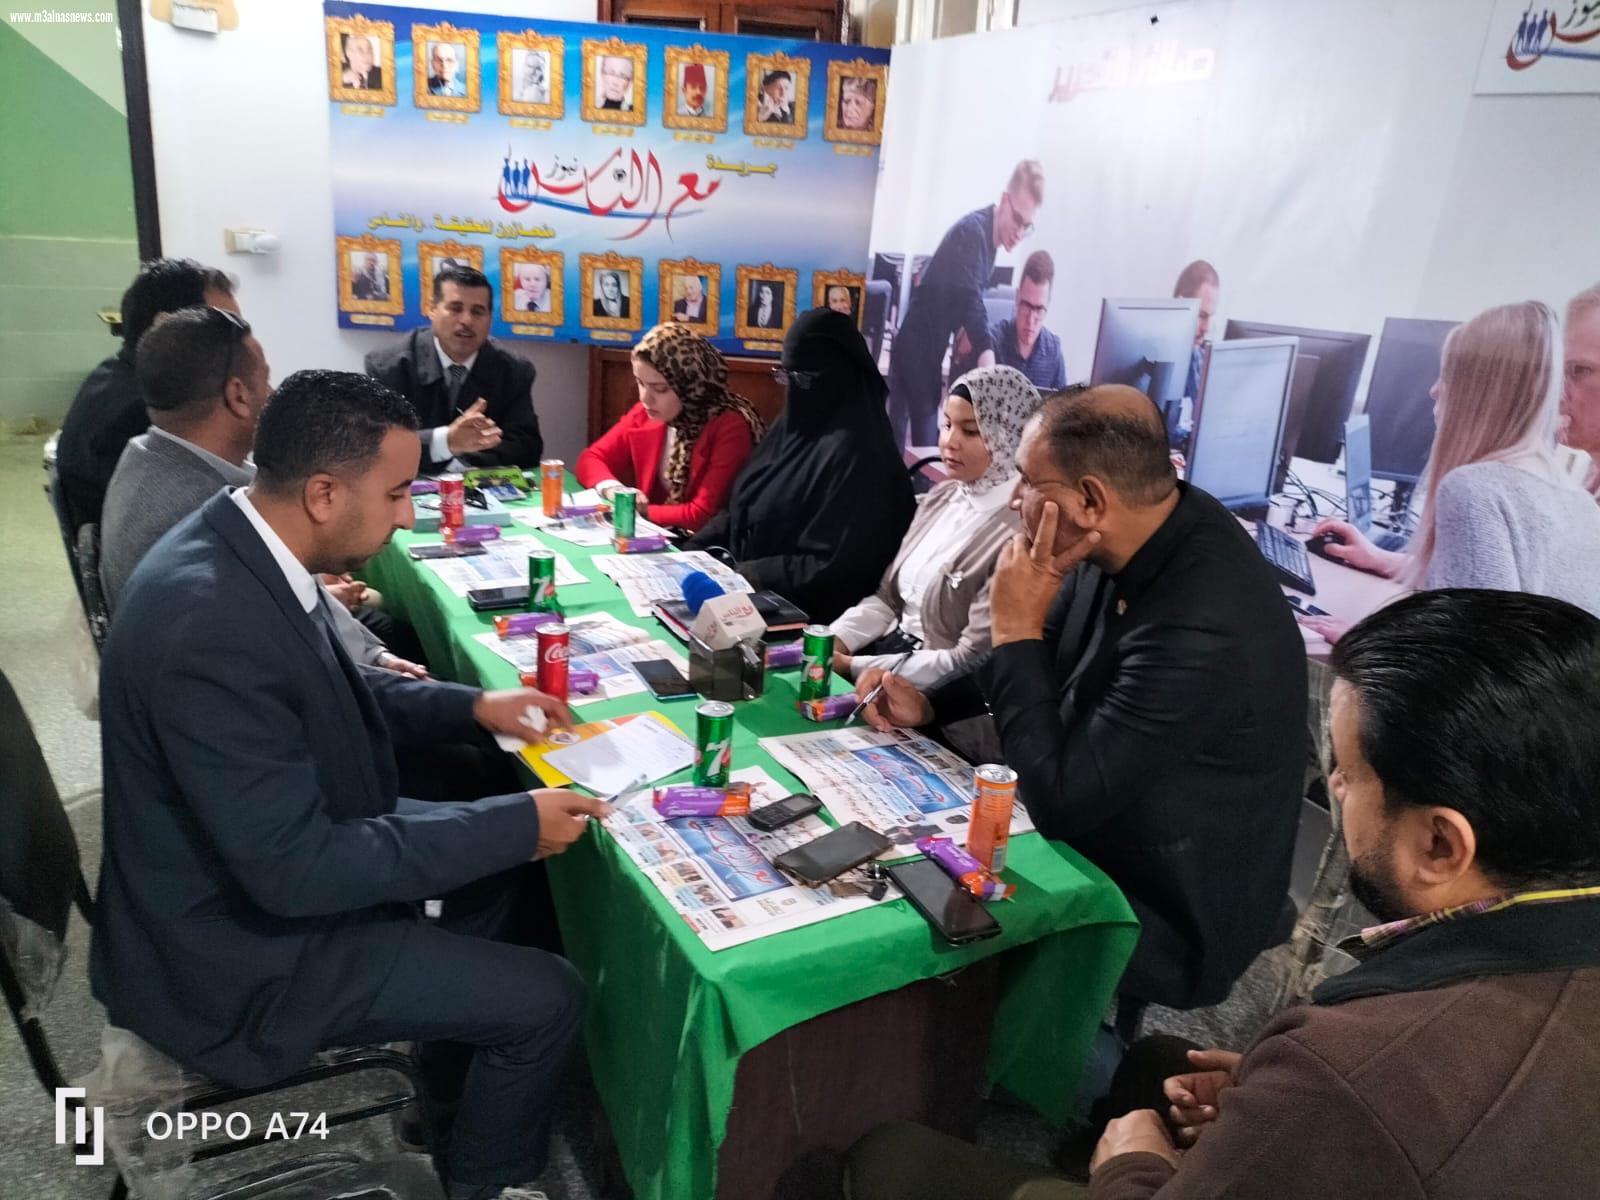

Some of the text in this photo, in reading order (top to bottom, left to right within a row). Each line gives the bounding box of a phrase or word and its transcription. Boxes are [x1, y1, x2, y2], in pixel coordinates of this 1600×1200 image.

[497, 146, 722, 244] مع الناس
[545, 155, 579, 182] نيوز
